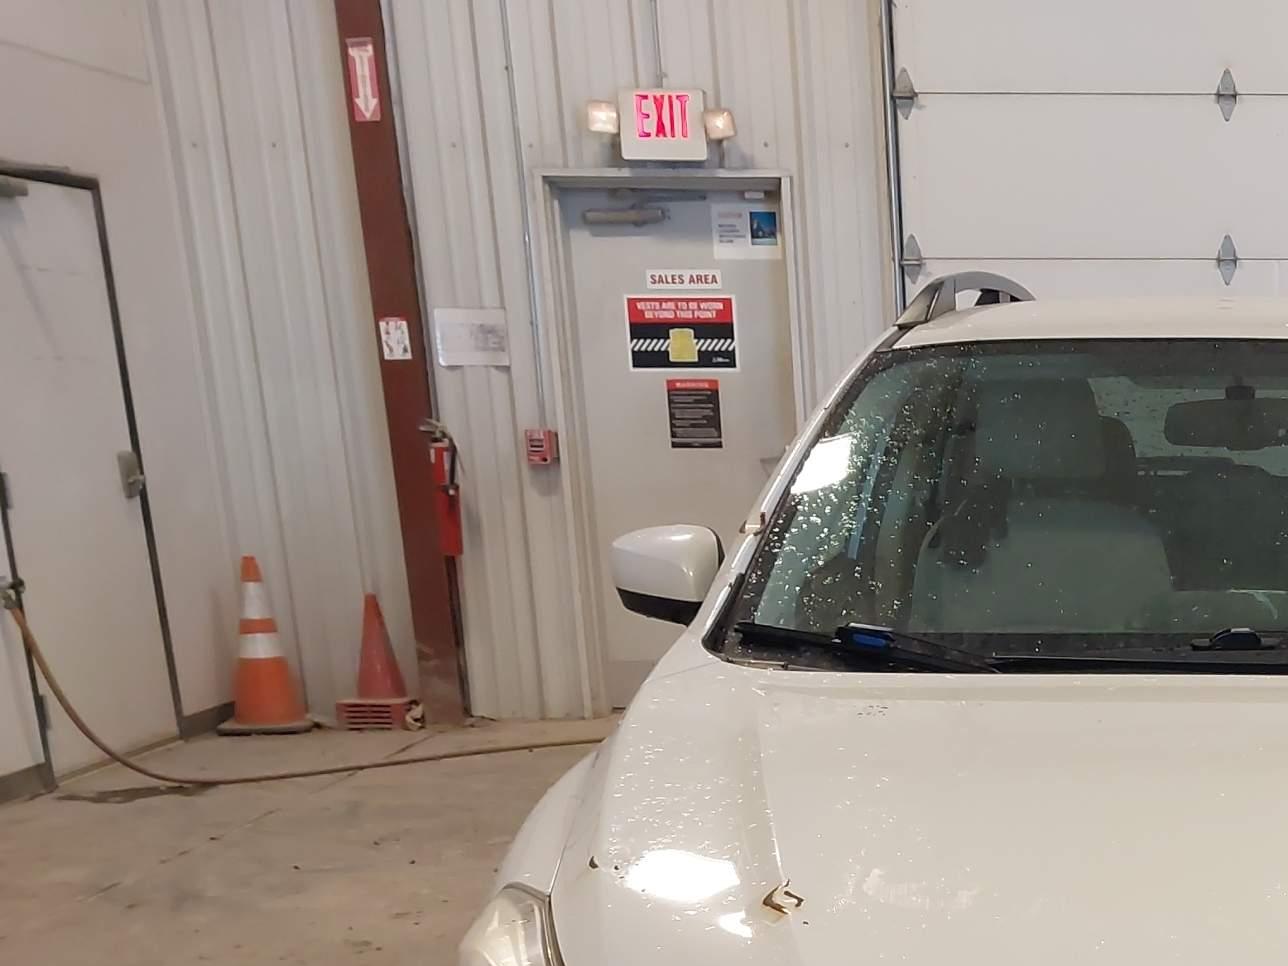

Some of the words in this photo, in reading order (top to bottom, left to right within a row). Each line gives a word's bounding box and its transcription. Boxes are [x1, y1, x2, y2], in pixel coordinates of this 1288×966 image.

[635, 94, 689, 138] EXIT
[650, 274, 685, 285] SALES
[688, 274, 718, 285] AREA
